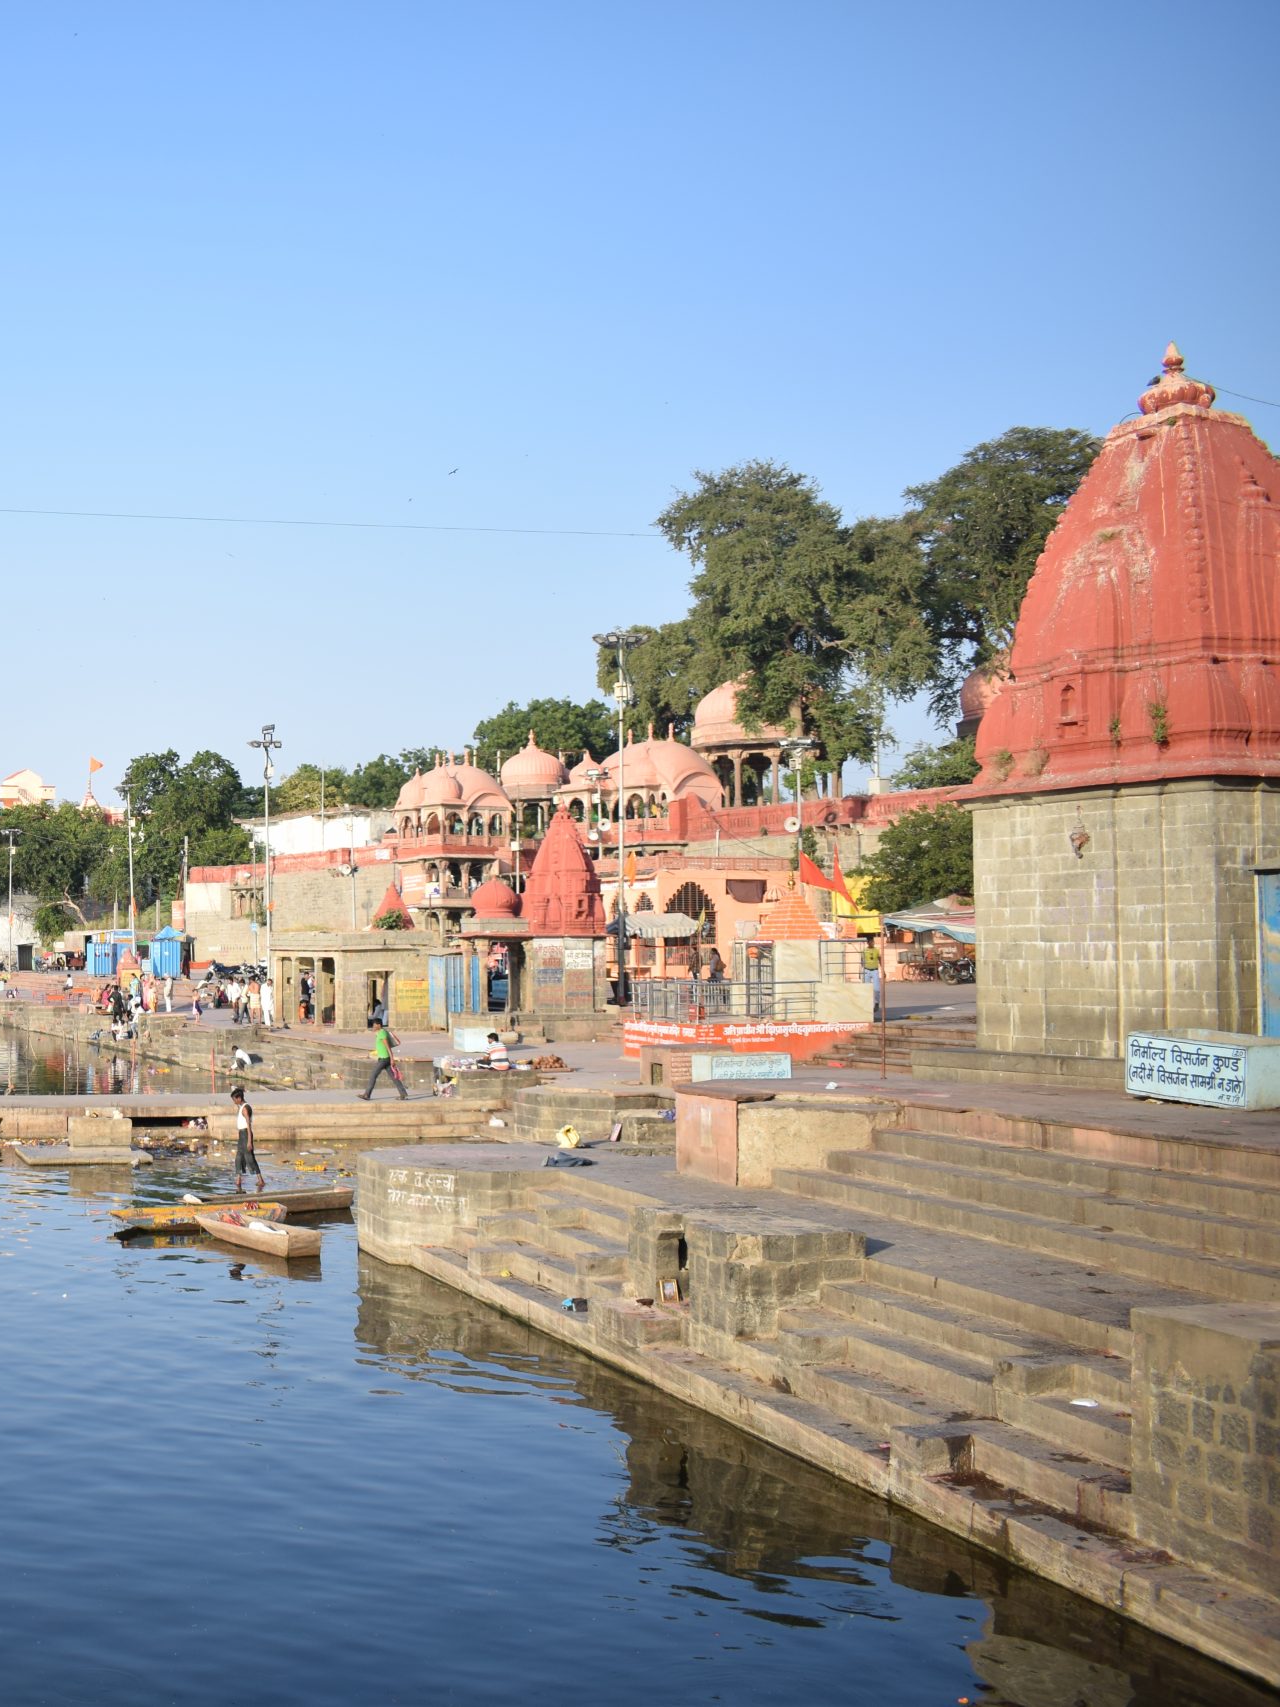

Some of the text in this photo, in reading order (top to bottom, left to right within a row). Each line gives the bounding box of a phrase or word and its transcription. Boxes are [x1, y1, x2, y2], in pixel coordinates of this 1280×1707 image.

[1130, 1039, 1241, 1073] निर्माल्य विसर्जन कुण्ड
[1157, 1065, 1188, 1086] विसर्जन
[1189, 1071, 1217, 1090] सामग्री
